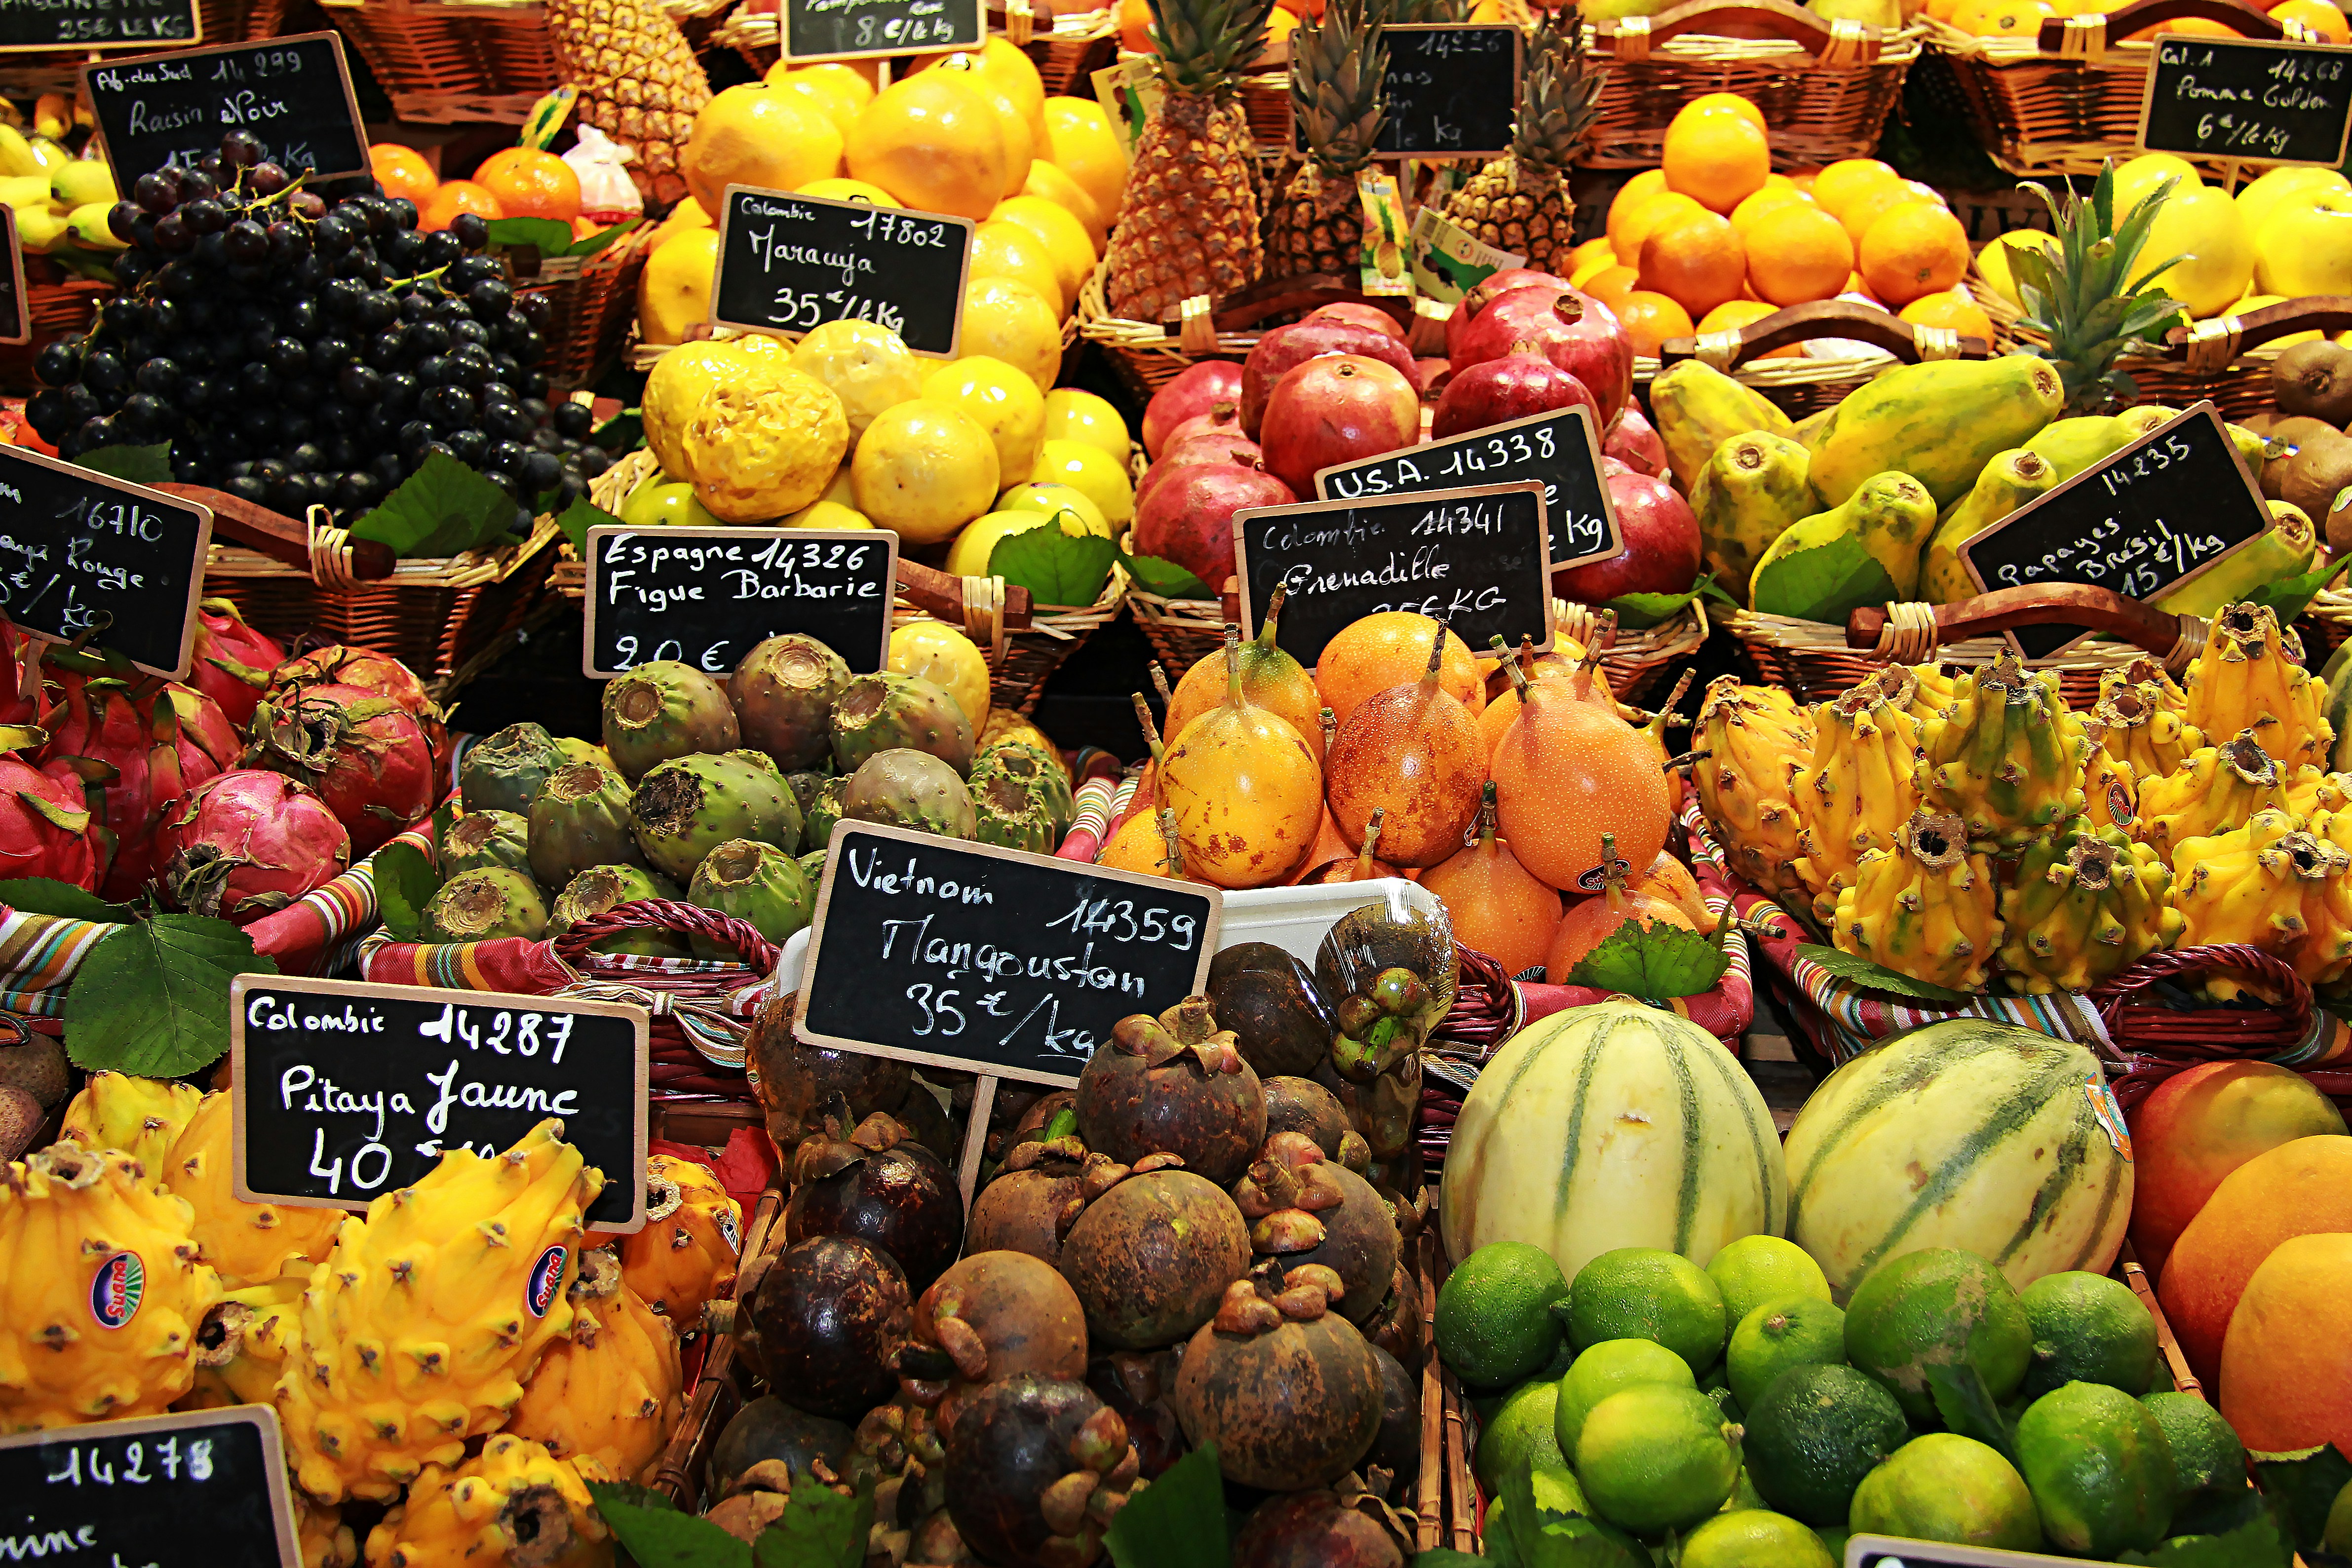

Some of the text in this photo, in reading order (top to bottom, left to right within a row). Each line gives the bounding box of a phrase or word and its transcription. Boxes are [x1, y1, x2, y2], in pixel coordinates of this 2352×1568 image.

[855, 14, 877, 47] 8
[129, 90, 289, 136] Raisin Noir
[850, 210, 947, 248] 17802
[1439, 426, 1556, 477] 14338
[2101, 435, 2191, 496] 14235
[1411, 503, 1504, 536] 14341
[68, 536, 145, 589] Rouge
[604, 532, 870, 578] Espagne 14326
[1283, 544, 1450, 596] Grenadille
[1997, 517, 2121, 586] Papayes
[609, 569, 882, 612] Figue Barbarie
[1045, 897, 1196, 951] 14359
[881, 913, 1145, 999] Mangoustan
[419, 1003, 574, 1064] 14287
[280, 1059, 580, 1142] Pitaya Jaune
[47, 1435, 215, 1486] 14278
